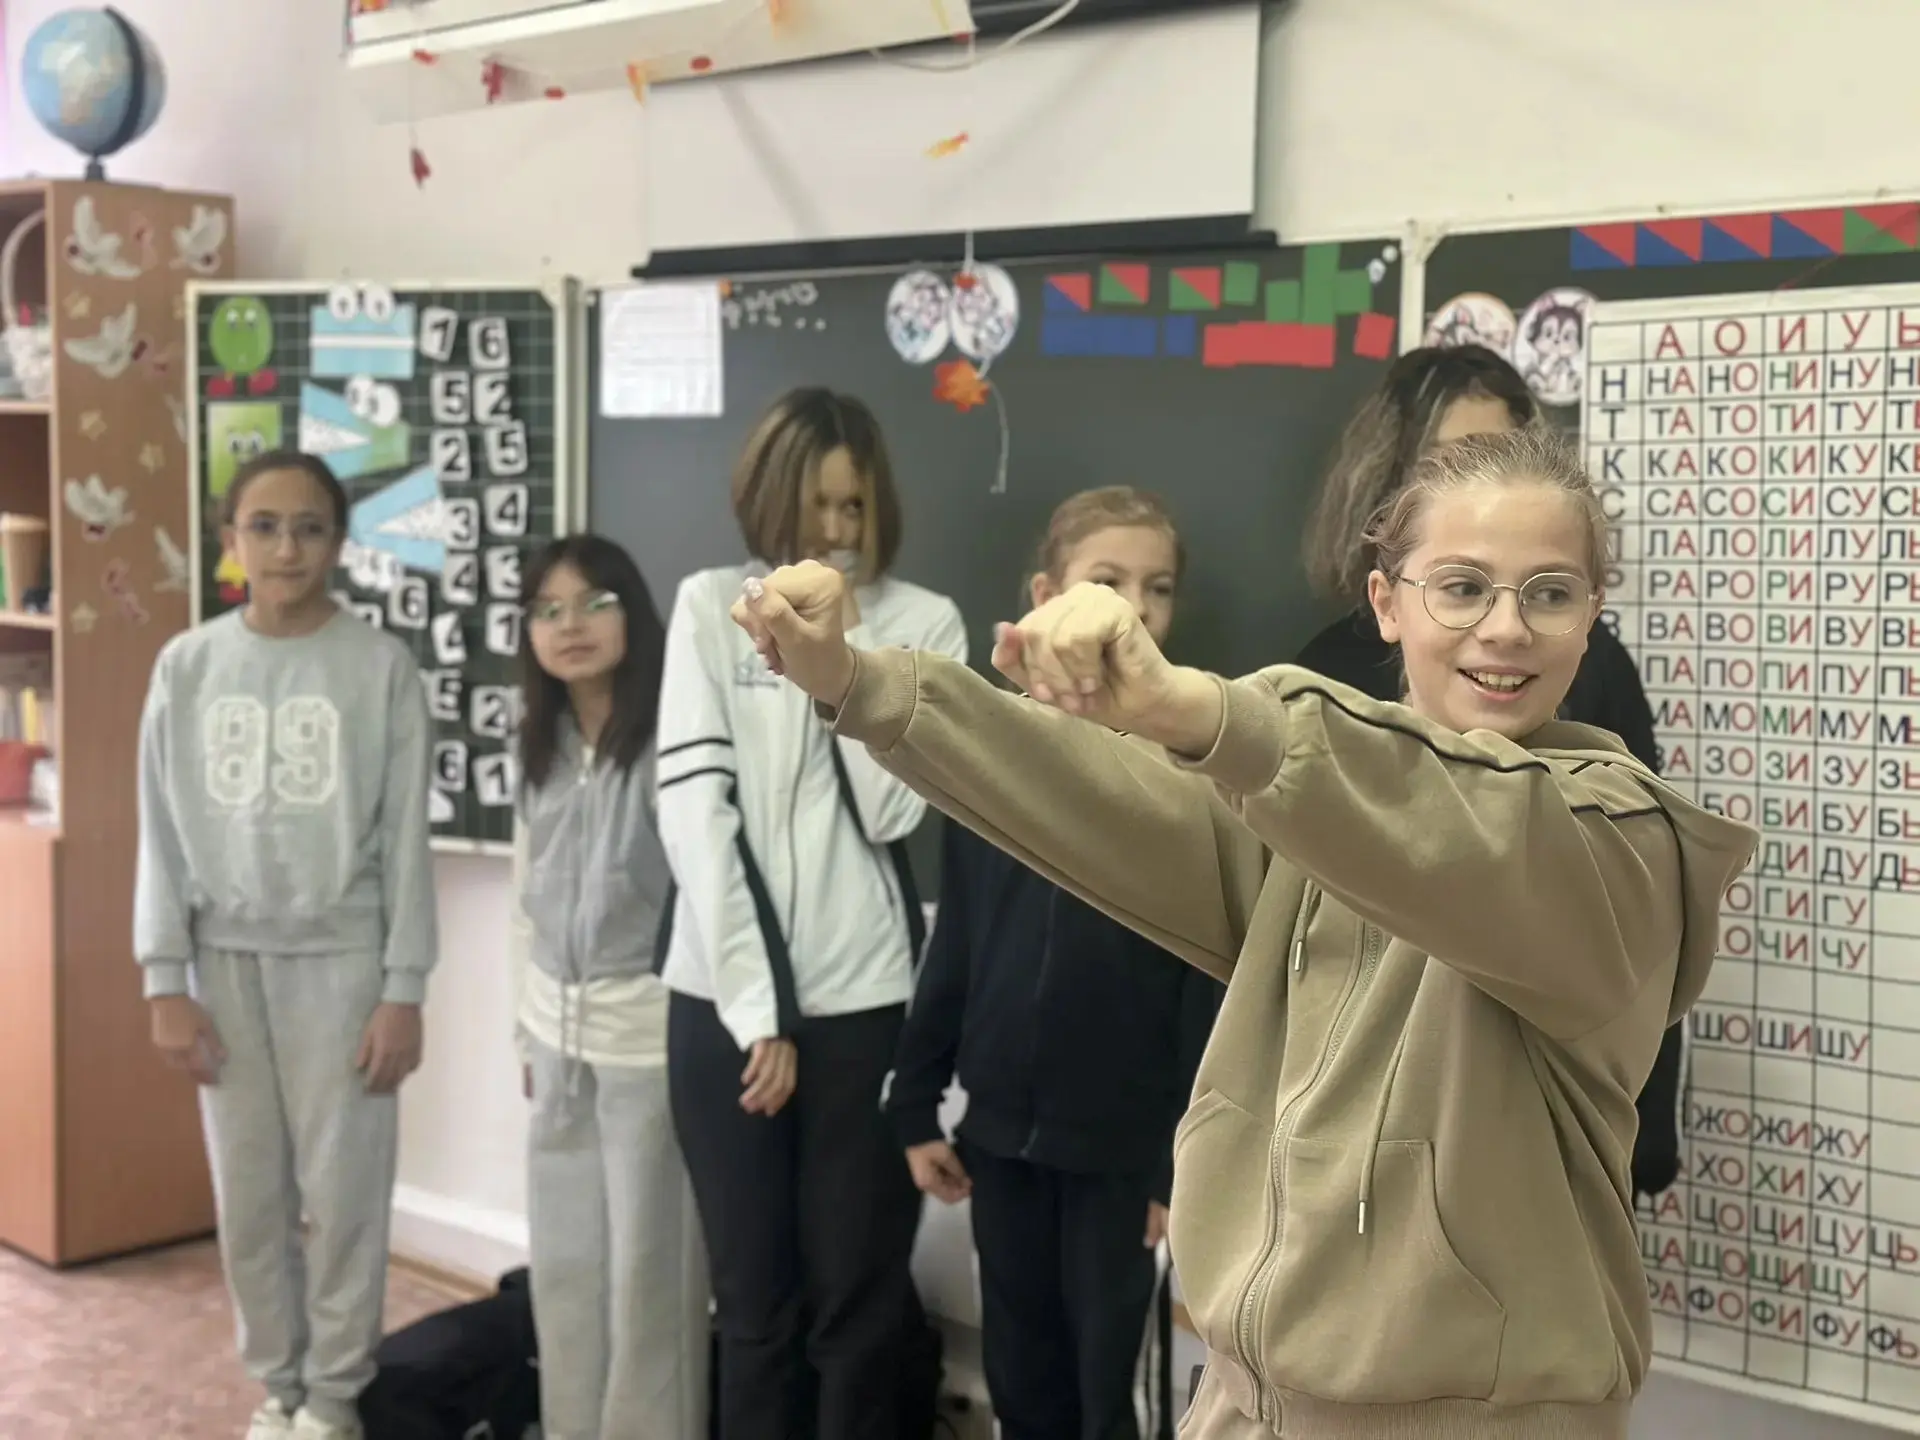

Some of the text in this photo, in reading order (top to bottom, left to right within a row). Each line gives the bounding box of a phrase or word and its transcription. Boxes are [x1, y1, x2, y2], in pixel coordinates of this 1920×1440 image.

[1656, 323, 1685, 359] А
[1714, 320, 1746, 357] О
[1779, 317, 1805, 353] И
[1842, 312, 1870, 350] У
[445, 380, 466, 415] 5
[1601, 357, 1920, 400] Н НА НО НИ НУ Н
[1601, 400, 1920, 441] Т ТА ТО ТИ ТУ Т
[443, 437, 464, 472] 2
[500, 430, 520, 465] 5
[1602, 444, 1920, 479] К КА КО КИ КУ К
[497, 490, 518, 528] 4
[1601, 488, 1625, 520] С
[1648, 488, 1696, 516] СА
[1705, 487, 1756, 517] СО
[1764, 486, 1813, 517] СИ
[1826, 486, 1876, 516] СУ
[452, 506, 470, 542] 3
[1648, 529, 1696, 556] ЛА
[1707, 528, 1756, 557] ЛО
[1766, 528, 1812, 558] ЛИ
[1824, 528, 1875, 558] ЛУ
[1649, 570, 1696, 598] РА
[1707, 570, 1755, 599] РО
[1767, 570, 1811, 600] РИ
[1826, 572, 1874, 602] РУ
[1647, 612, 1694, 640] ВА
[1706, 612, 1754, 643] ВО
[1767, 614, 1811, 644] ВИ
[1826, 616, 1872, 647] ВУ
[1646, 655, 1694, 684] ПА
[1705, 658, 1754, 688] ПО
[1763, 661, 1808, 692] ПИ
[1822, 664, 1870, 695] ПУ
[1704, 702, 1756, 731] МО
[1763, 705, 1811, 736] МИ
[1821, 709, 1871, 740] МУ
[204, 695, 340, 806] 89
[1705, 746, 1753, 776] ЗО
[1765, 751, 1808, 781] ЗИ
[1823, 755, 1868, 786] ЗУ
[487, 762, 507, 795] 1
[1763, 797, 1808, 828] БИ
[1822, 803, 1868, 833] БУ
[1761, 841, 1808, 879] ДИ
[1821, 847, 1868, 885] ДУ
[1765, 887, 1808, 919] ГИ
[1824, 895, 1867, 926] ГУ
[1759, 928, 1808, 962] ЧИ
[1822, 936, 1867, 970] ЧУ
[1693, 1012, 1871, 1062] ШО ШИ ШУ
[1693, 1103, 1869, 1158] ЖО ЖИ ЖУ
[1696, 1151, 1863, 1206] ХО ХИ ХУ
[1695, 1193, 1744, 1233] ЦО
[1755, 1204, 1803, 1245] ЦИ
[1815, 1215, 1864, 1257] ЦУ
[1689, 1240, 1747, 1280] ЩО
[1751, 1252, 1811, 1293] ЩИ
[1811, 1264, 1867, 1306] ЩУ
[1688, 1286, 1743, 1321] ФО
[1752, 1298, 1801, 1335] ФИ
[1813, 1312, 1861, 1346] ФУ
